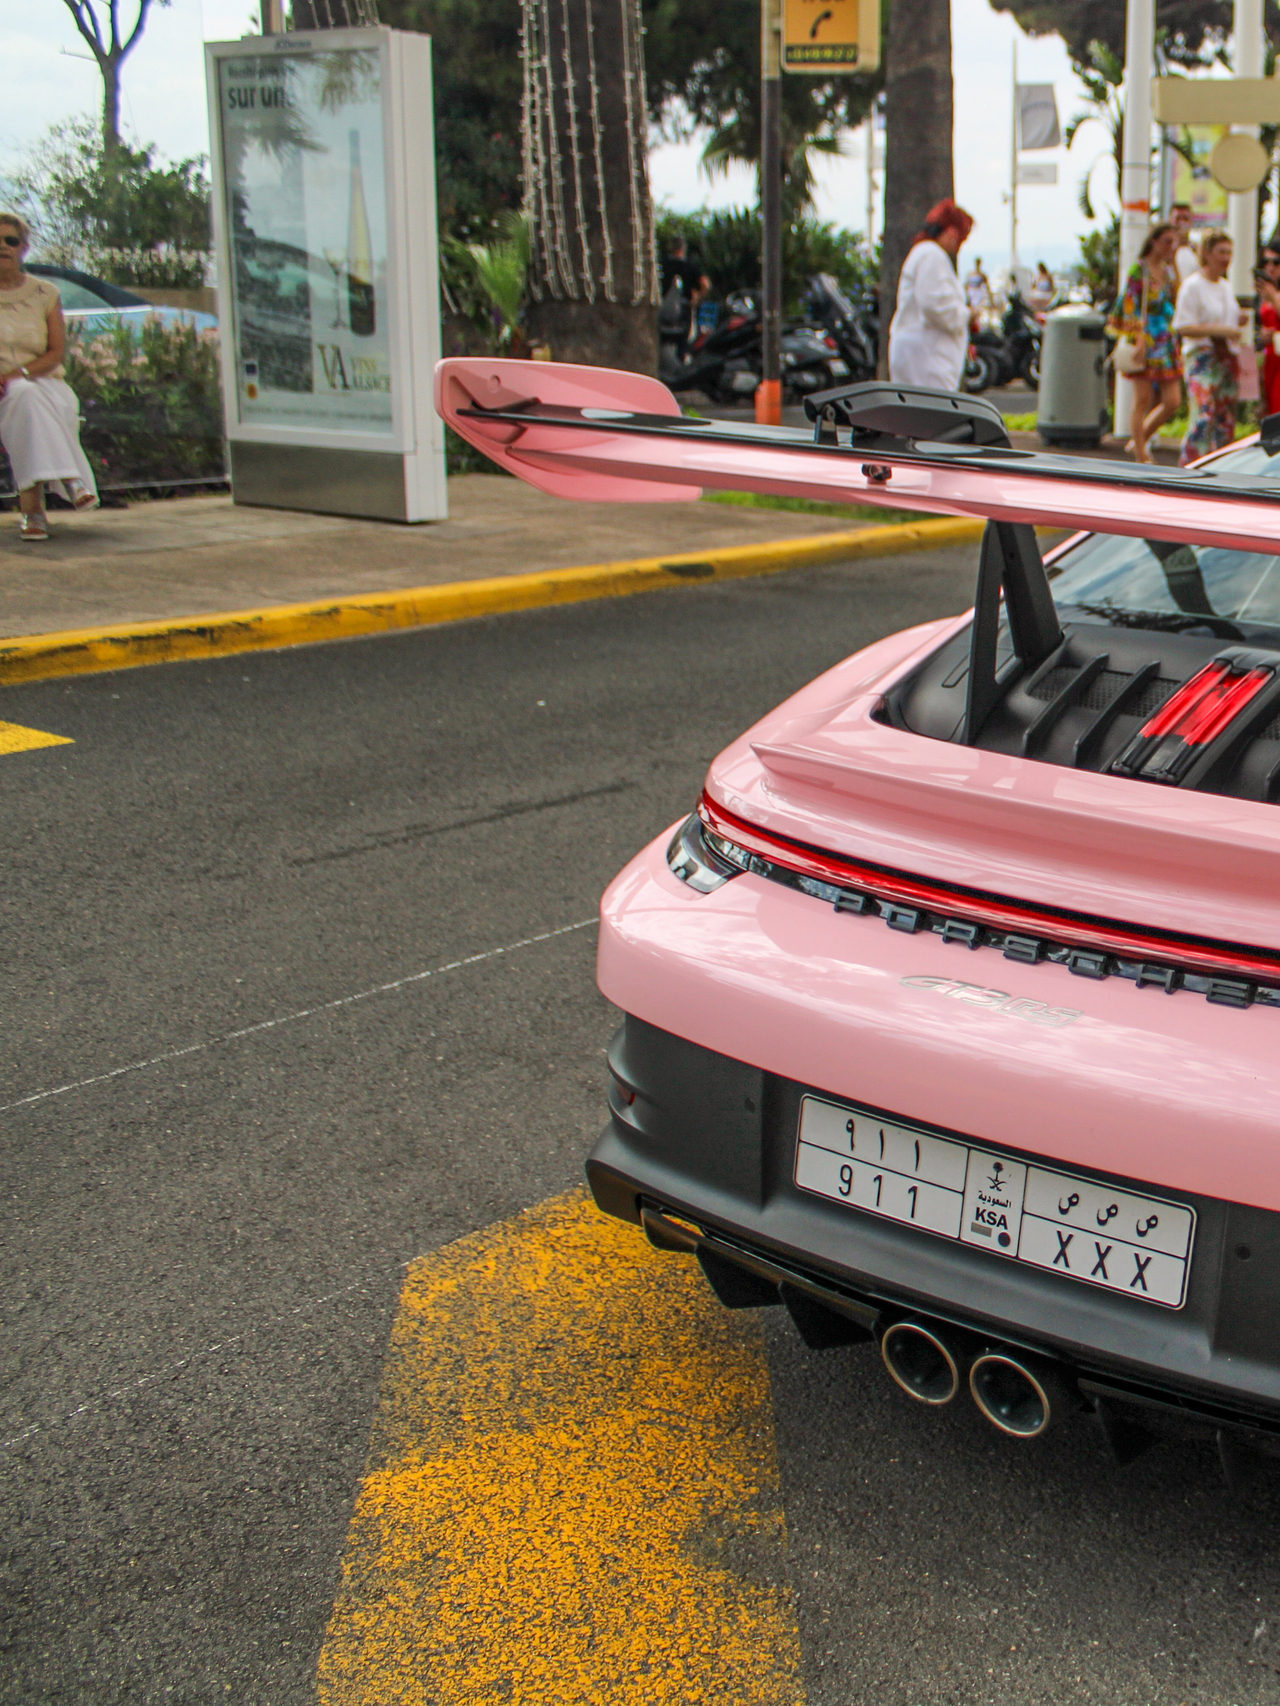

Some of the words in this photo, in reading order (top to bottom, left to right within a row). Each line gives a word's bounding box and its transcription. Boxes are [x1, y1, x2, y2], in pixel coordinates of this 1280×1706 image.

[228, 86, 256, 109] sur
[834, 891, 1257, 1009] PORSCHE
[977, 1189, 1012, 1209] السعودية
[974, 1206, 1009, 1231] KSA
